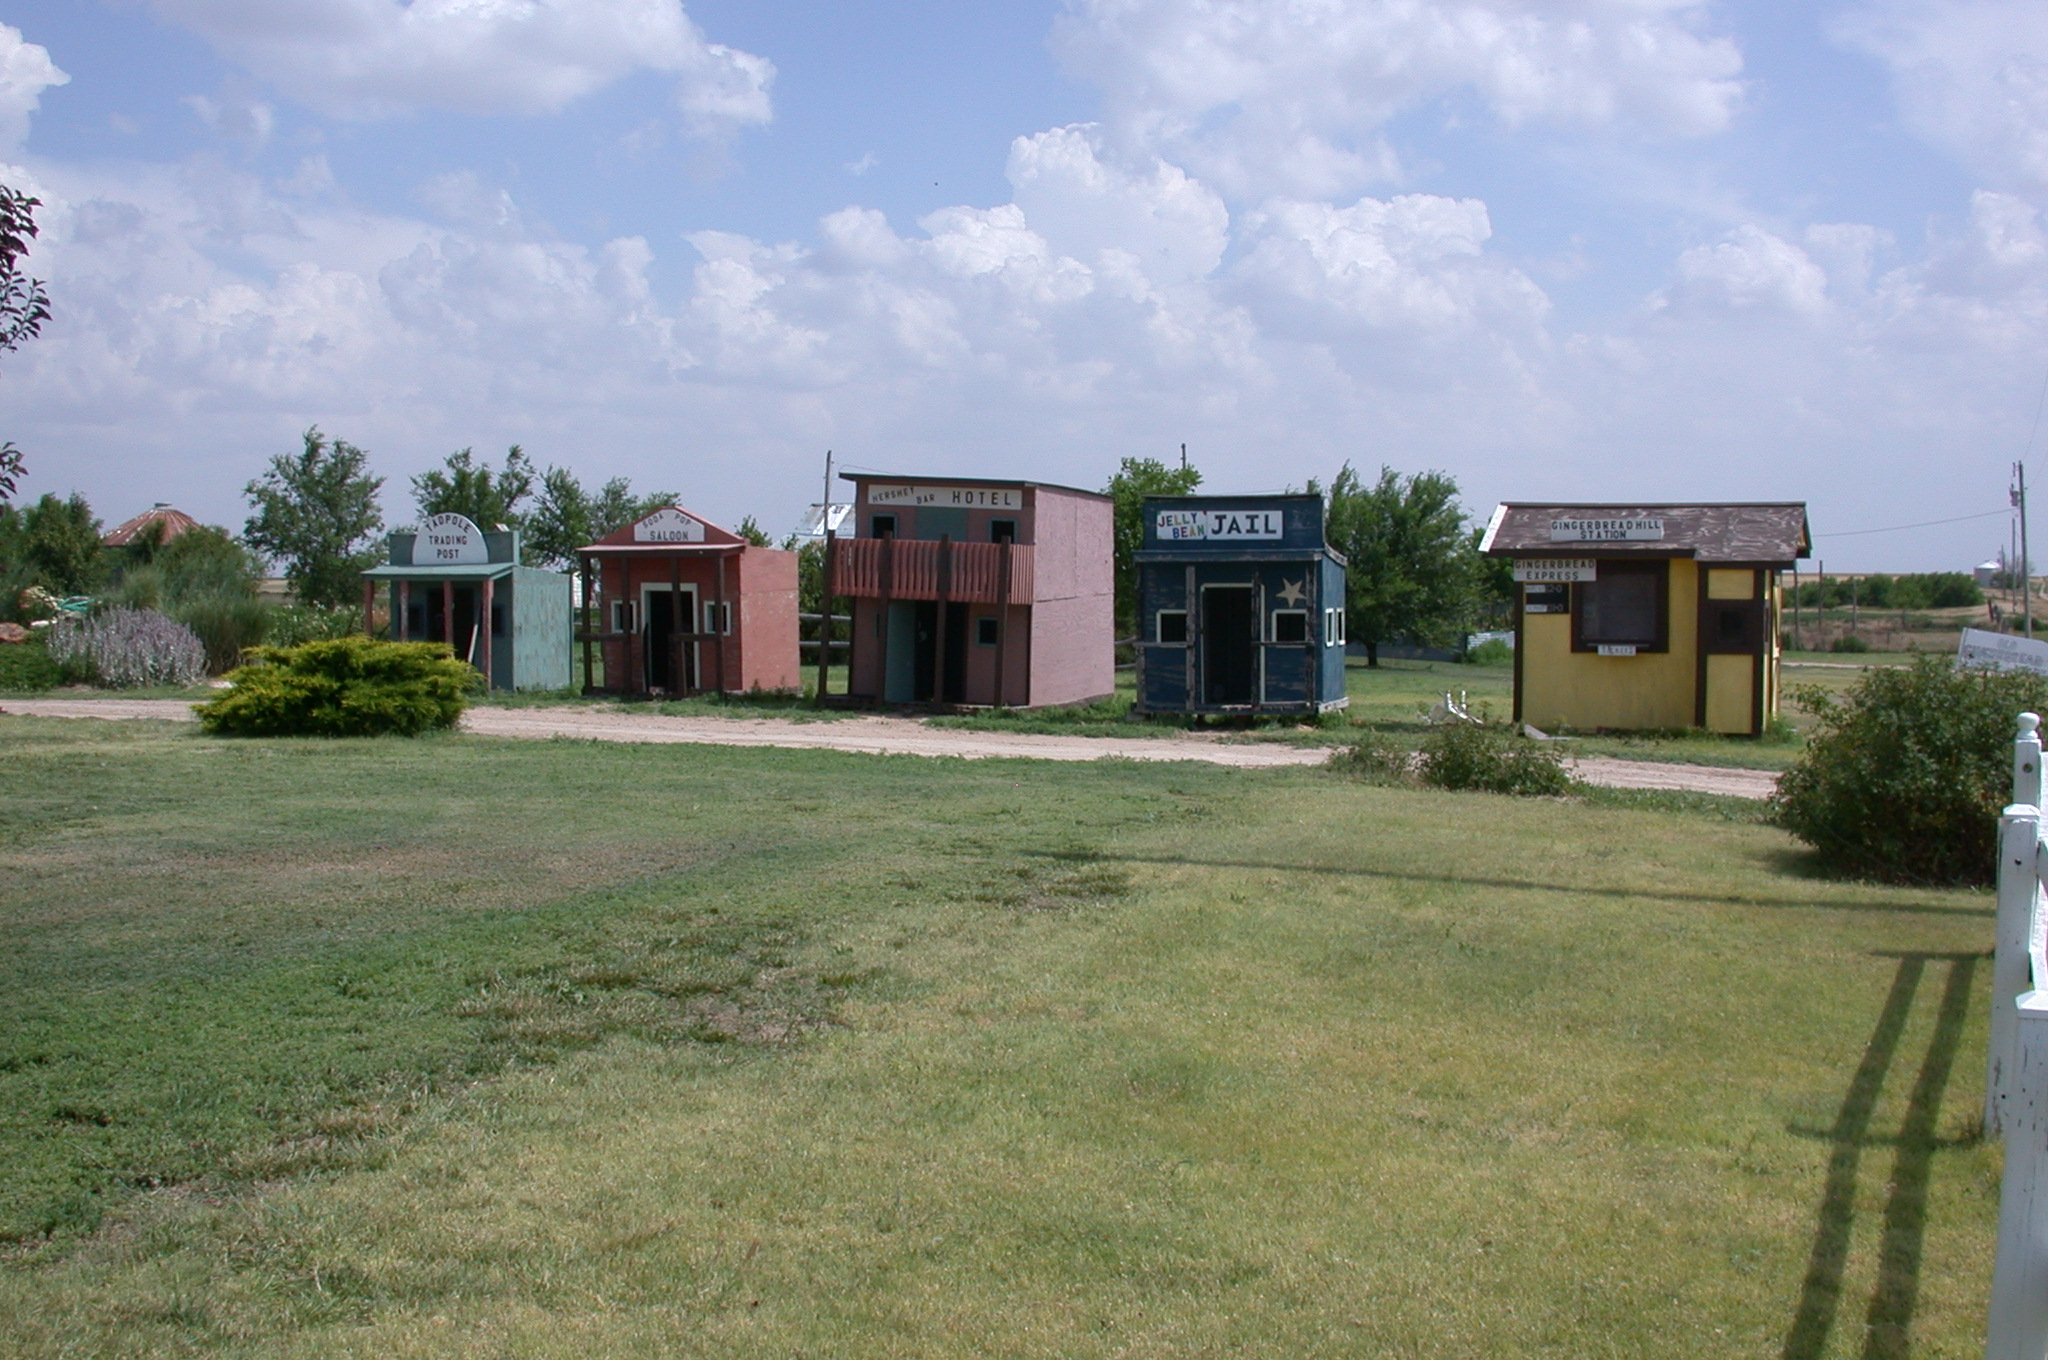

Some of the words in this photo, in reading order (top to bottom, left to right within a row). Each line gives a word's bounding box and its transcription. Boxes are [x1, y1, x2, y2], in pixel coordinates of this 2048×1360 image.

[872, 486, 915, 504] HERSHEY
[916, 493, 936, 505] BAR
[952, 490, 1012, 506] HOTEL
[426, 514, 471, 534] TADPOLE
[642, 512, 664, 529] SODA
[674, 512, 692, 526] POP
[1157, 512, 1198, 528] JELLY
[1211, 513, 1277, 535] JAIL
[1551, 520, 1634, 531] GINGERBREAD
[1635, 520, 1661, 530] HILL
[649, 530, 689, 541] SALOON
[1172, 525, 1205, 539] BEAN
[1580, 530, 1627, 540] STATION
[429, 535, 468, 546] TRADING
[437, 548, 459, 559] POST
[1514, 560, 1596, 570] GINGERBREAD
[1526, 570, 1580, 581] EXPRESS
